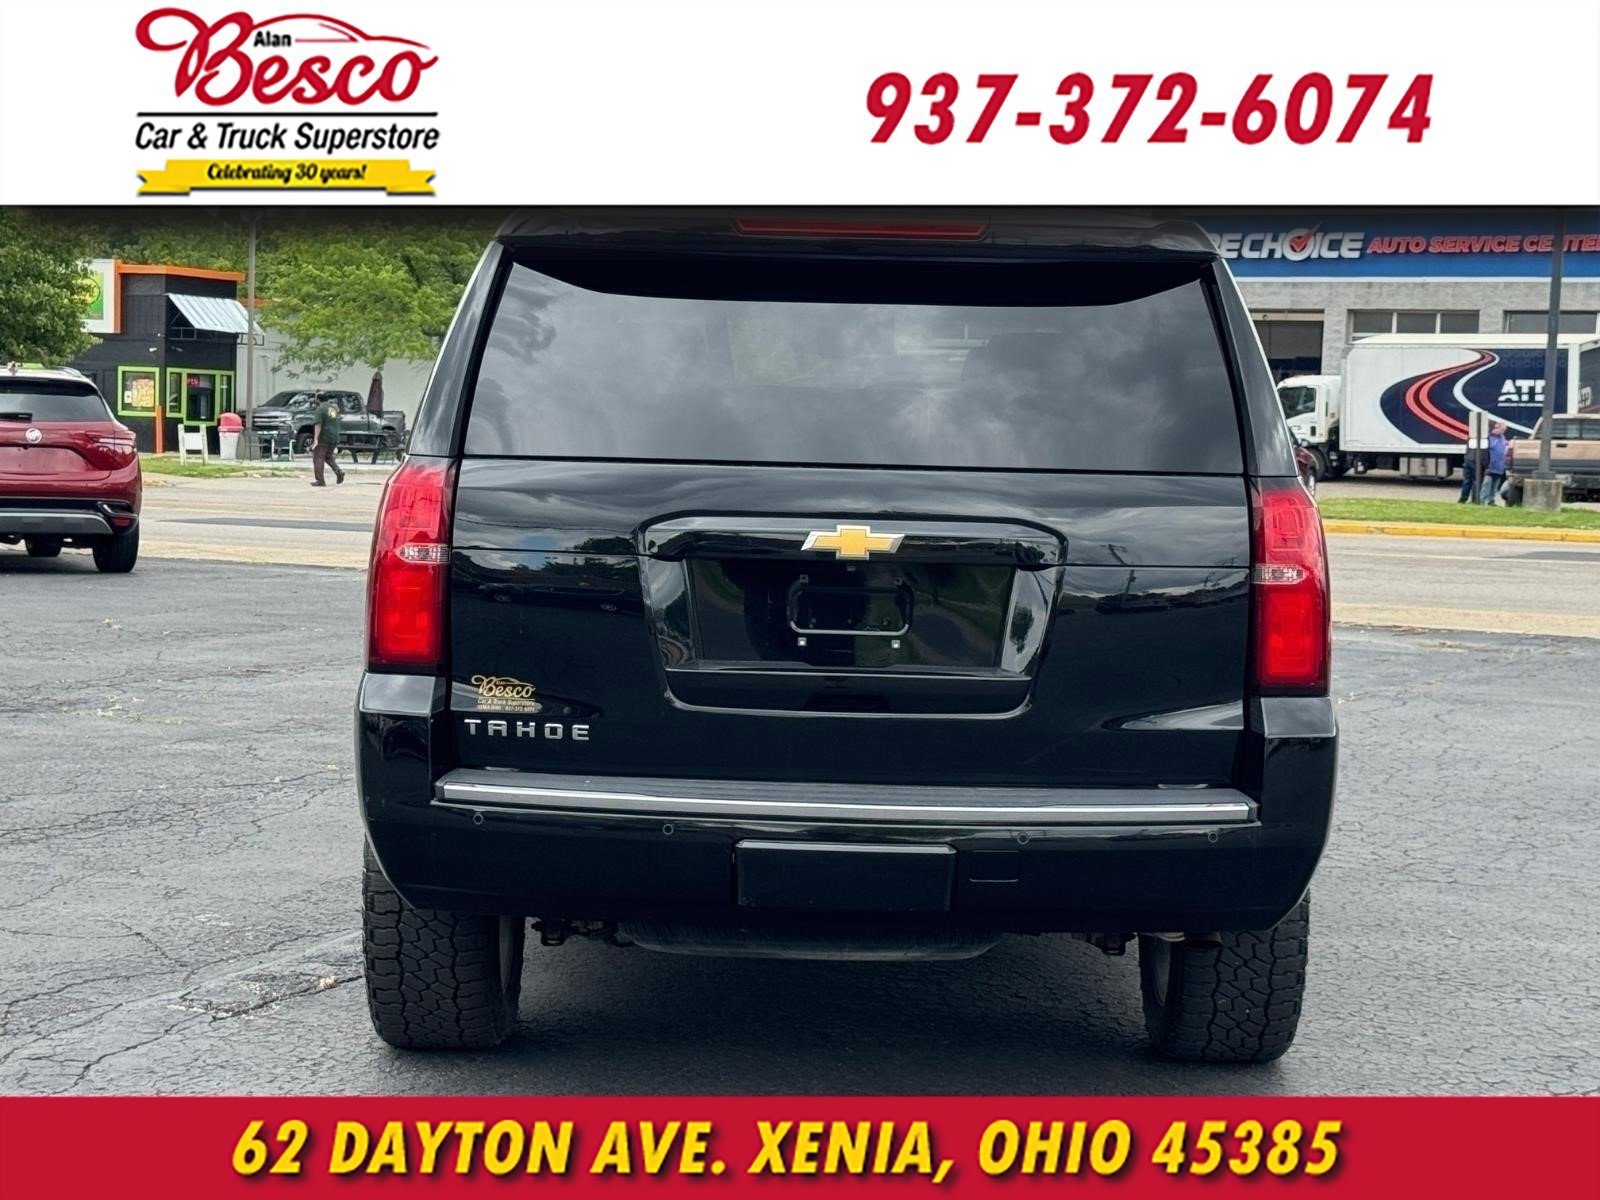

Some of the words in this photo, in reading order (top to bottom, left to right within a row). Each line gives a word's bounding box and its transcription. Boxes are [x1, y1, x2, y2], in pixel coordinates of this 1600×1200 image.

[1366, 236, 1426, 253] AUTO
[1428, 235, 1520, 253] SERVICE
[1523, 234, 1600, 252] CETE
[471, 675, 536, 698] Besco
[464, 719, 590, 741] TAHOE
